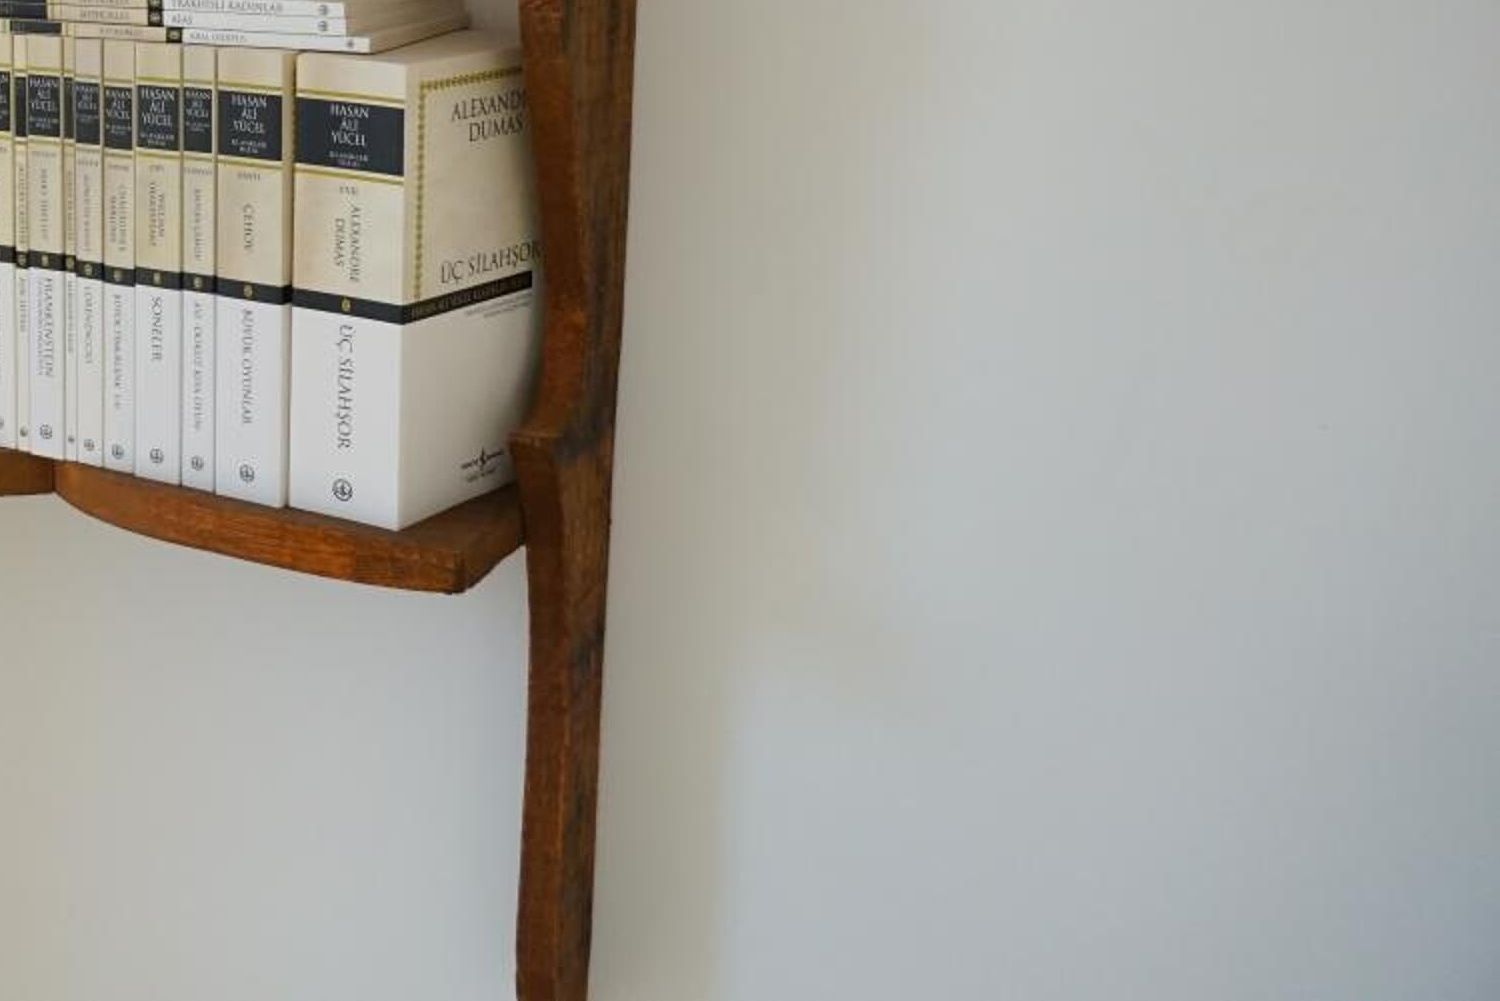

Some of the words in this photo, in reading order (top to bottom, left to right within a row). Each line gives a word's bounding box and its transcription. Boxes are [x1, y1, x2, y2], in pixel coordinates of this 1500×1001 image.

[140, 88, 175, 101] HASAN
[231, 94, 267, 108] HASAN
[330, 103, 370, 118] HASAN
[233, 119, 265, 134] YÜCEL
[468, 115, 524, 142] DUMAS
[331, 129, 366, 147] YÜCEL
[334, 218, 346, 268] DUMAS
[350, 206, 364, 283] ALEXANDRE
[440, 258, 465, 285] ÜÇ
[43, 277, 53, 377] FRANKENSTEIN
